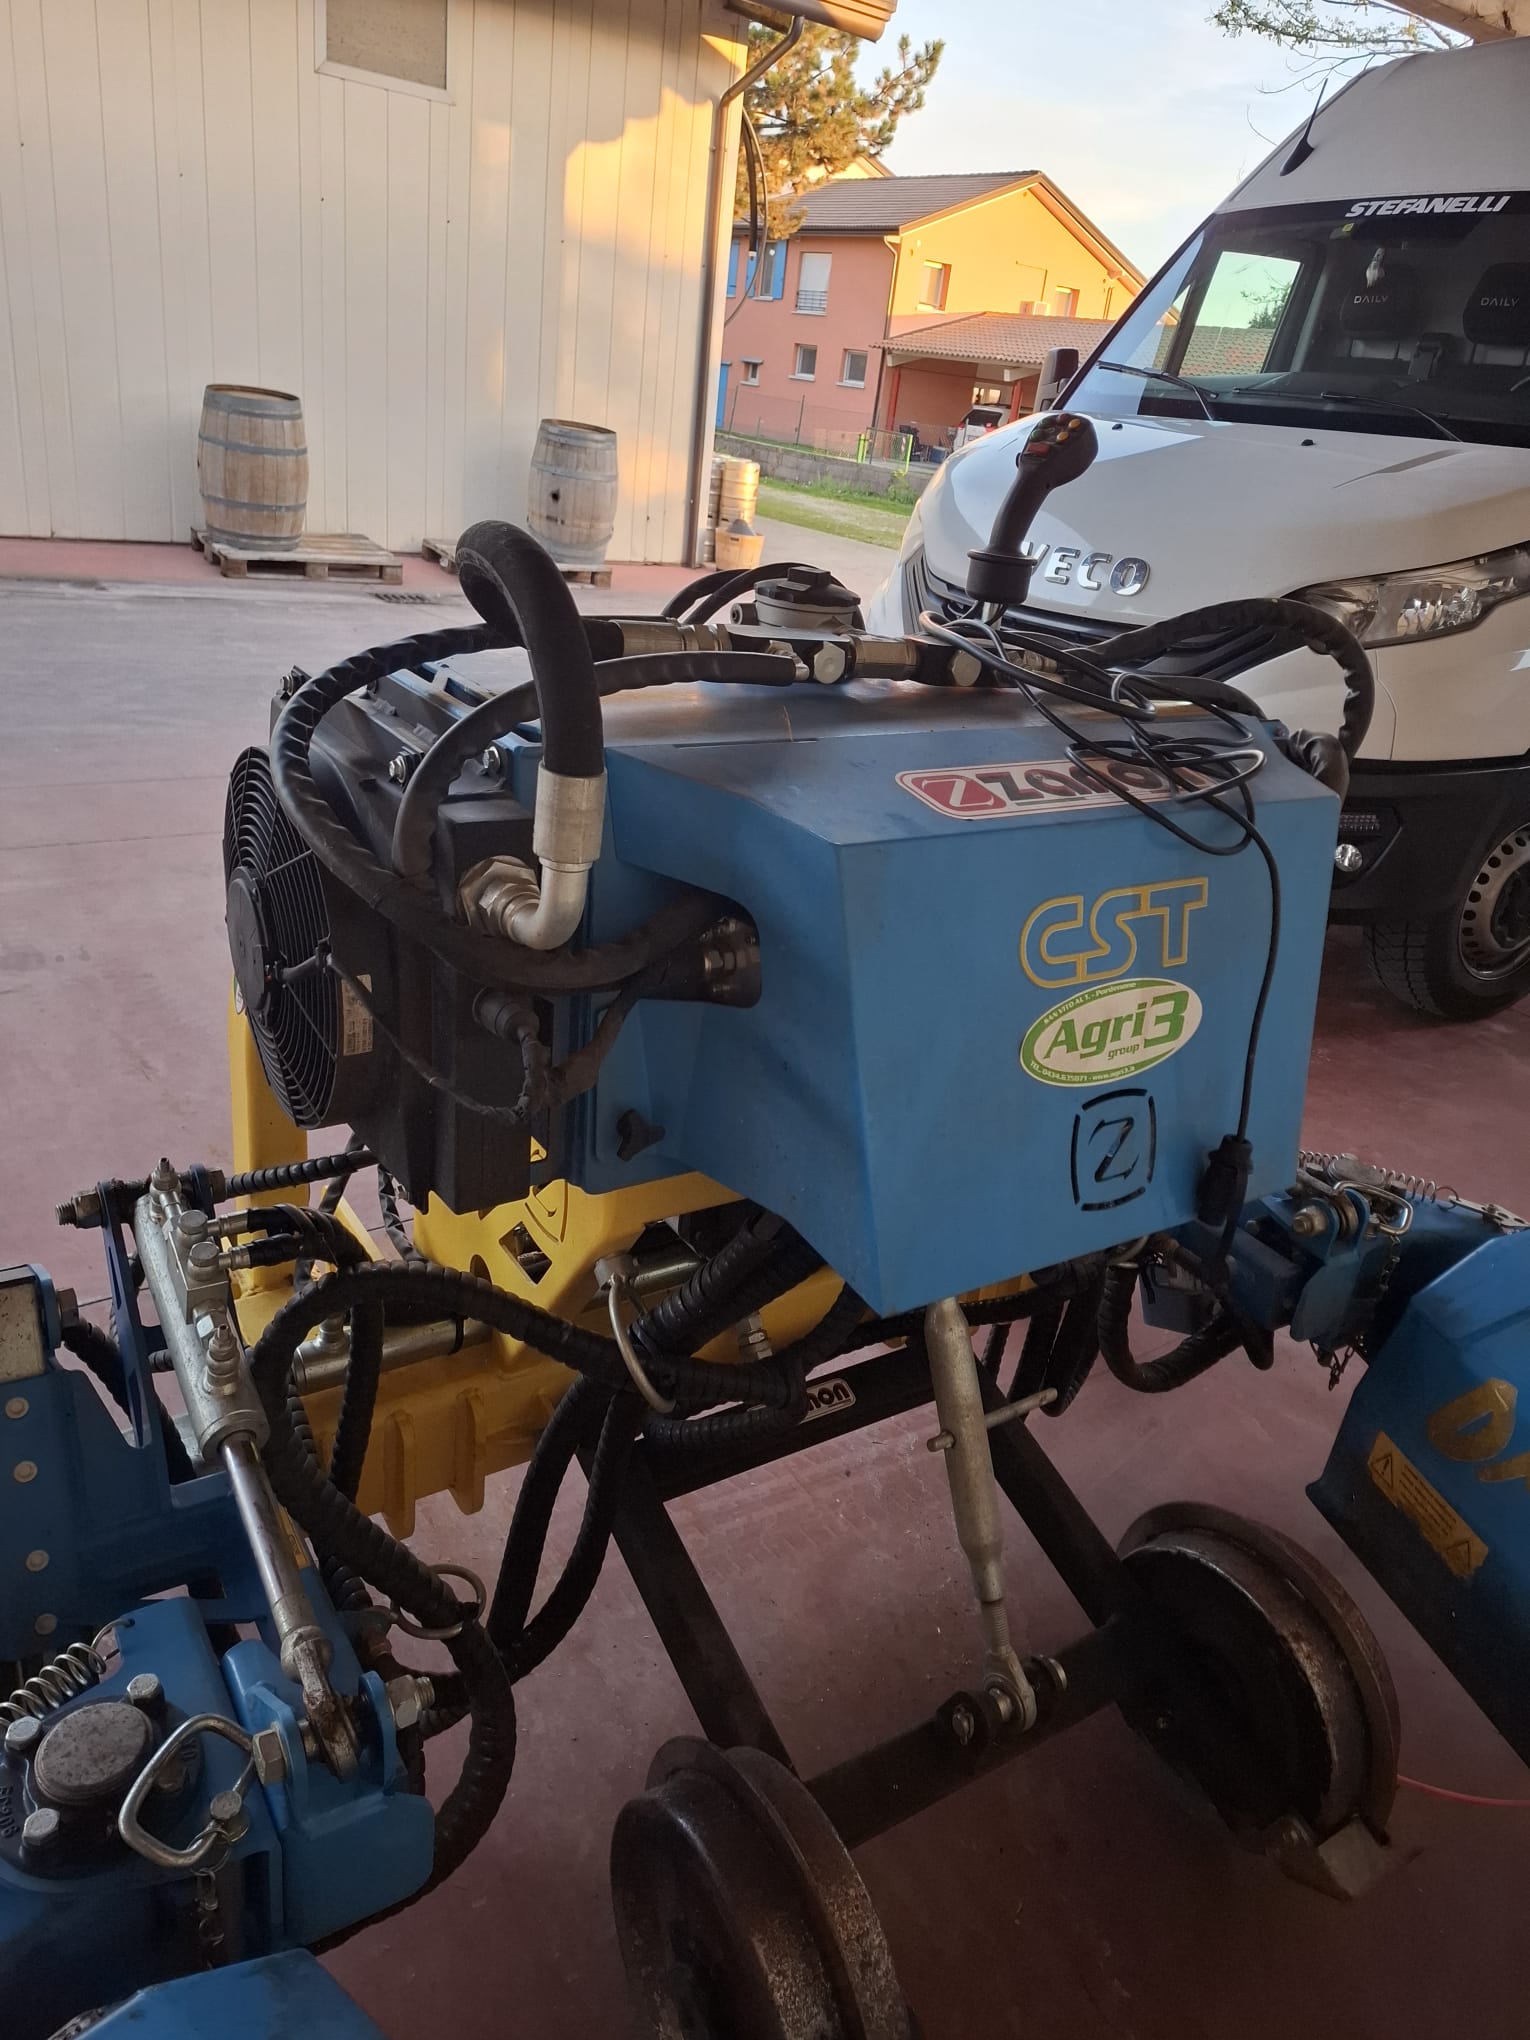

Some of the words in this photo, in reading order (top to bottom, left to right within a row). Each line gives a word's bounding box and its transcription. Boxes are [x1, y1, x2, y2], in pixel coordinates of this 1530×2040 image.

[1345, 195, 1511, 217] STEFANELLI
[1353, 295, 1389, 304] DAILY
[1480, 297, 1520, 307] DAILY
[1020, 541, 1151, 597] VECO
[1019, 877, 1209, 989] CST
[1043, 990, 1190, 1060] Agri3
[1107, 1043, 1140, 1061] group
